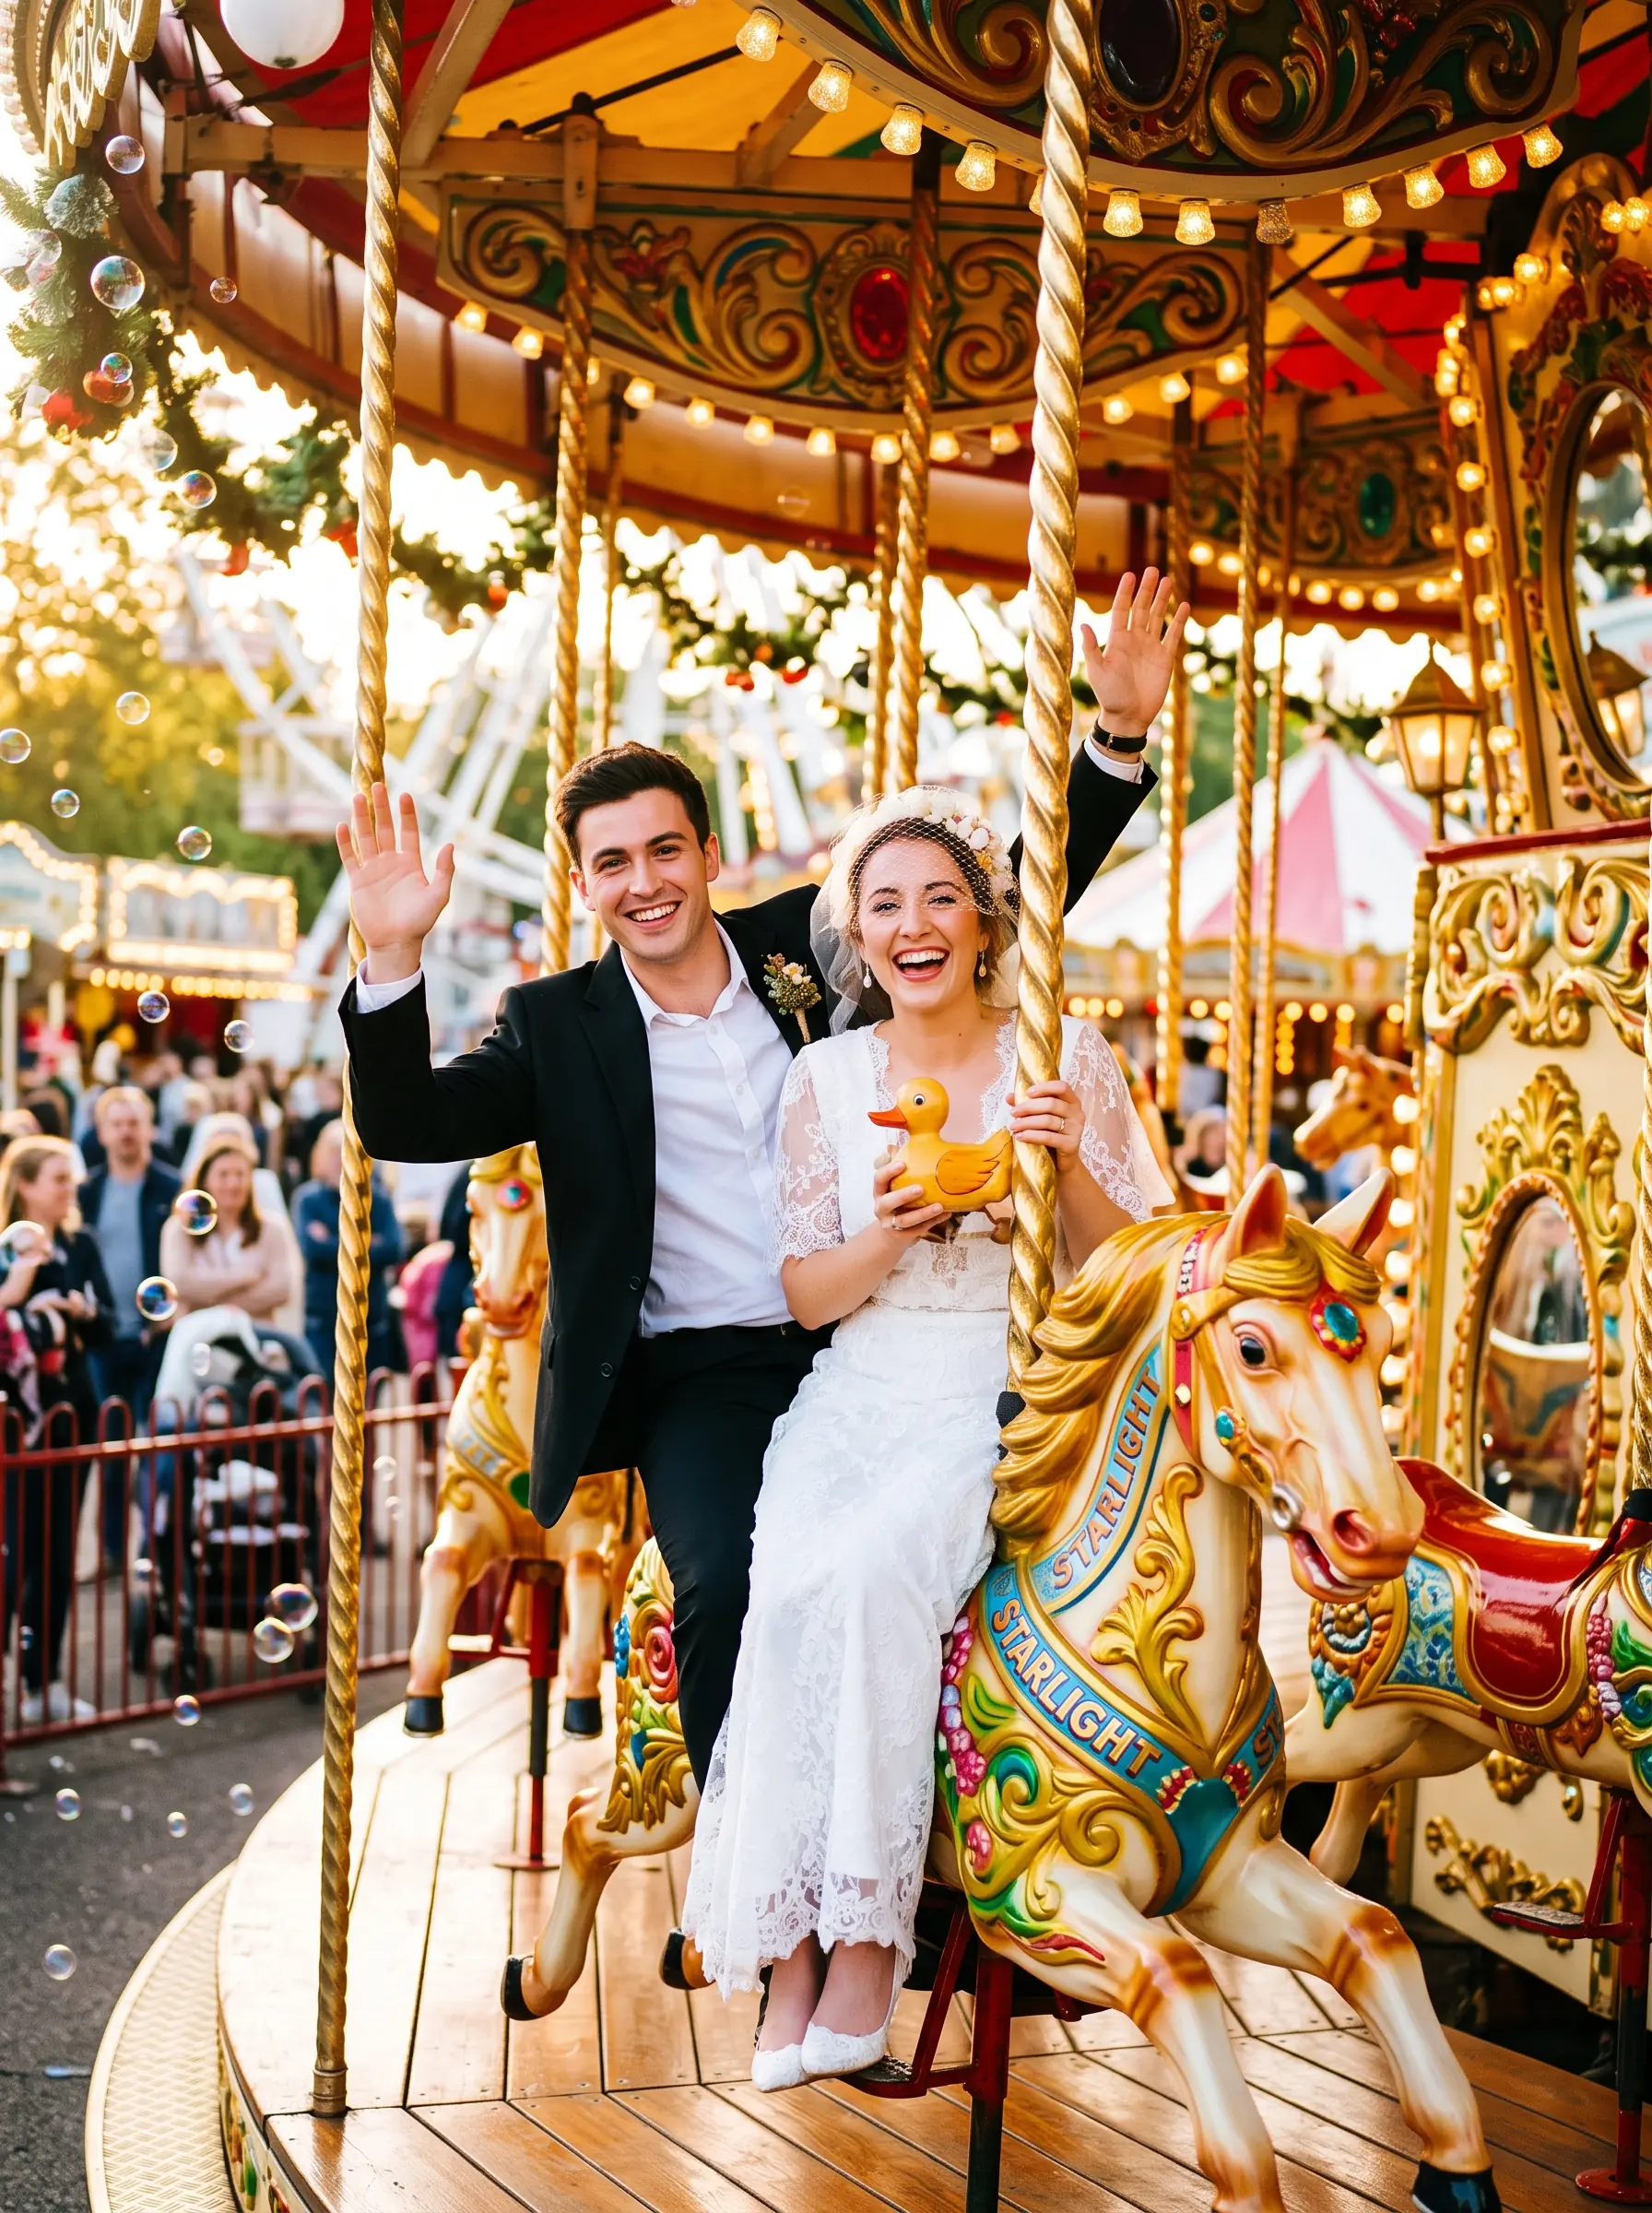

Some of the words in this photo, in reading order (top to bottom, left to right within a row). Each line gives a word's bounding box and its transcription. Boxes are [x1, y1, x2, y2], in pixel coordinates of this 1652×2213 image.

[1053, 1366, 1160, 1590] STARLIGHT
[992, 1599, 1162, 1778] STARLIGHT
[1253, 1698, 1282, 1769] ST
